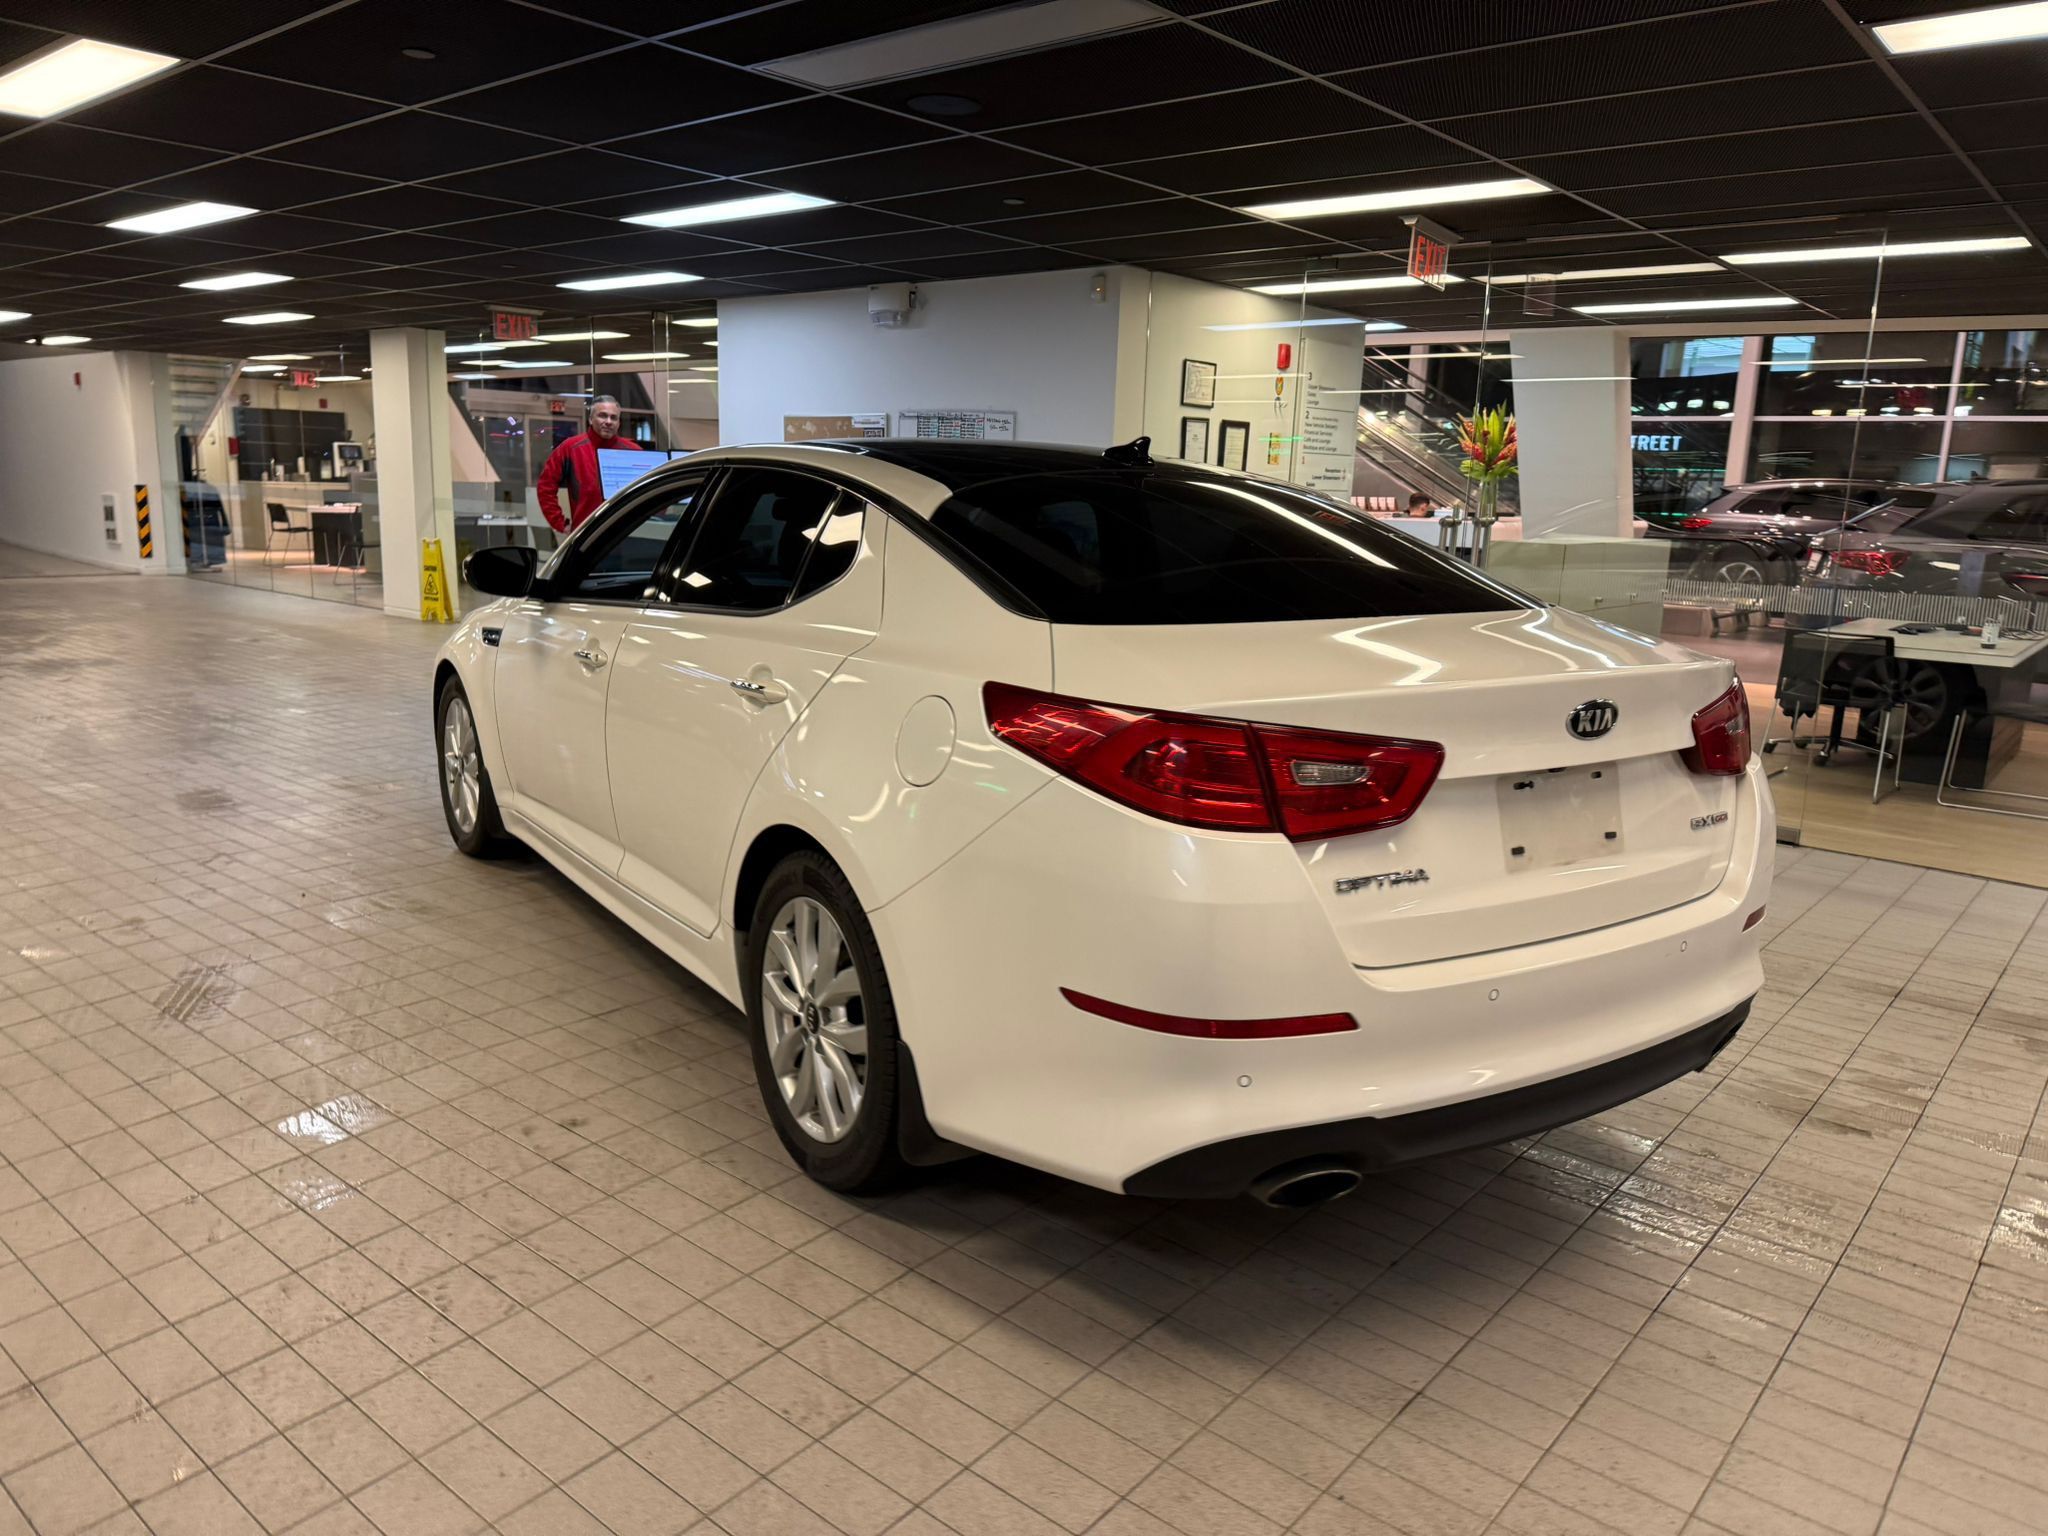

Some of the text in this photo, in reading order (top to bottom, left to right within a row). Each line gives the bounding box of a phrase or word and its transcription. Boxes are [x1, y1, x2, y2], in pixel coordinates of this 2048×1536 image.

[1415, 235, 1446, 285] EXIT
[496, 313, 531, 338] EXIT
[1305, 411, 1310, 419] 2
[1576, 707, 1614, 733] KIA
[1335, 868, 1430, 894] OPTIMA
